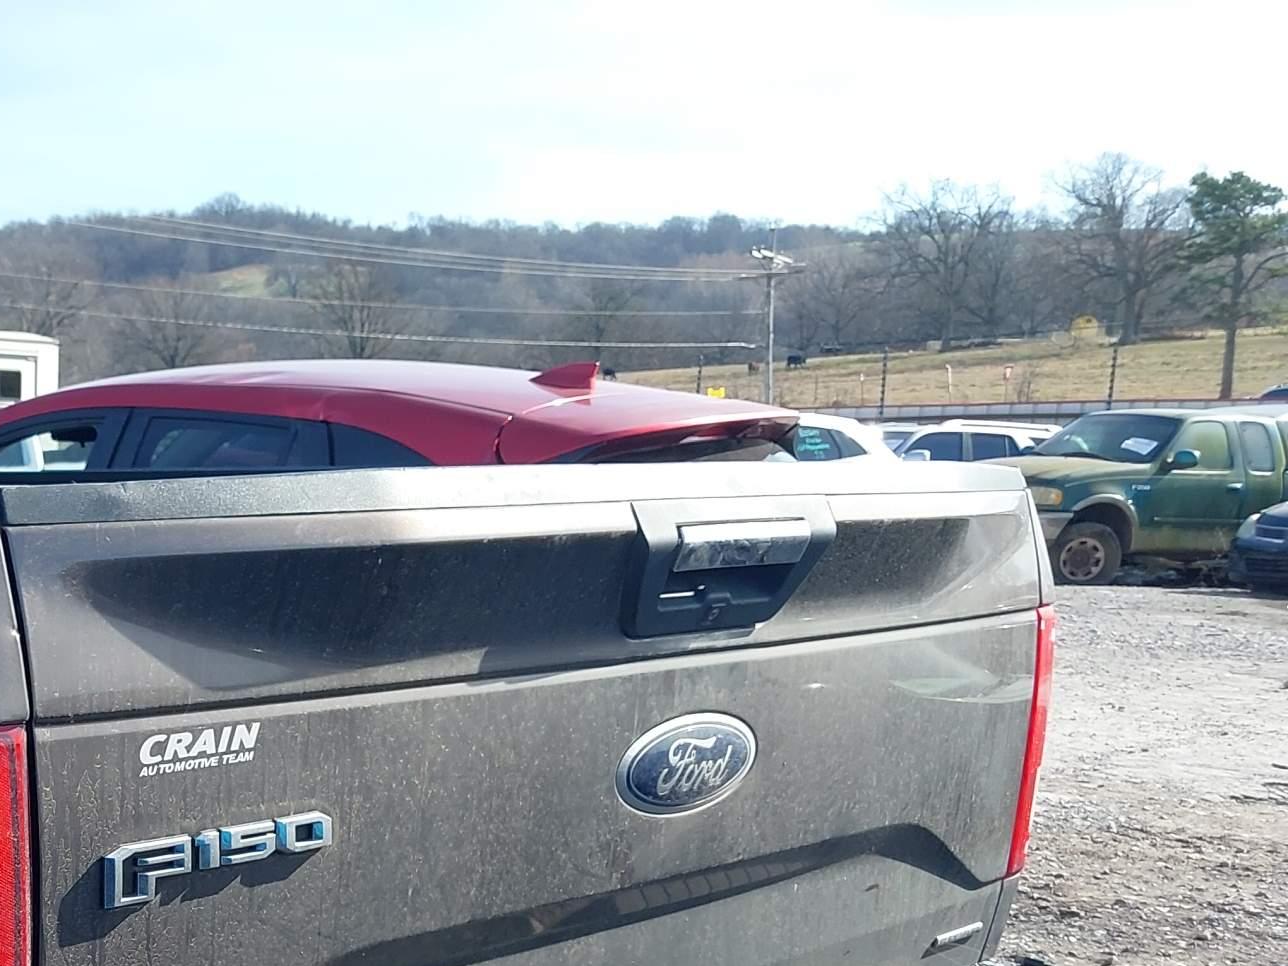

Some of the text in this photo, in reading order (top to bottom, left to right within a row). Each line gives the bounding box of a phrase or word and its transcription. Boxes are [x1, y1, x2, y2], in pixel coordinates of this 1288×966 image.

[139, 722, 261, 765] CRAIN
[139, 751, 254, 777] AUTOMOTIVE TEAM
[657, 735, 732, 795] Ford
